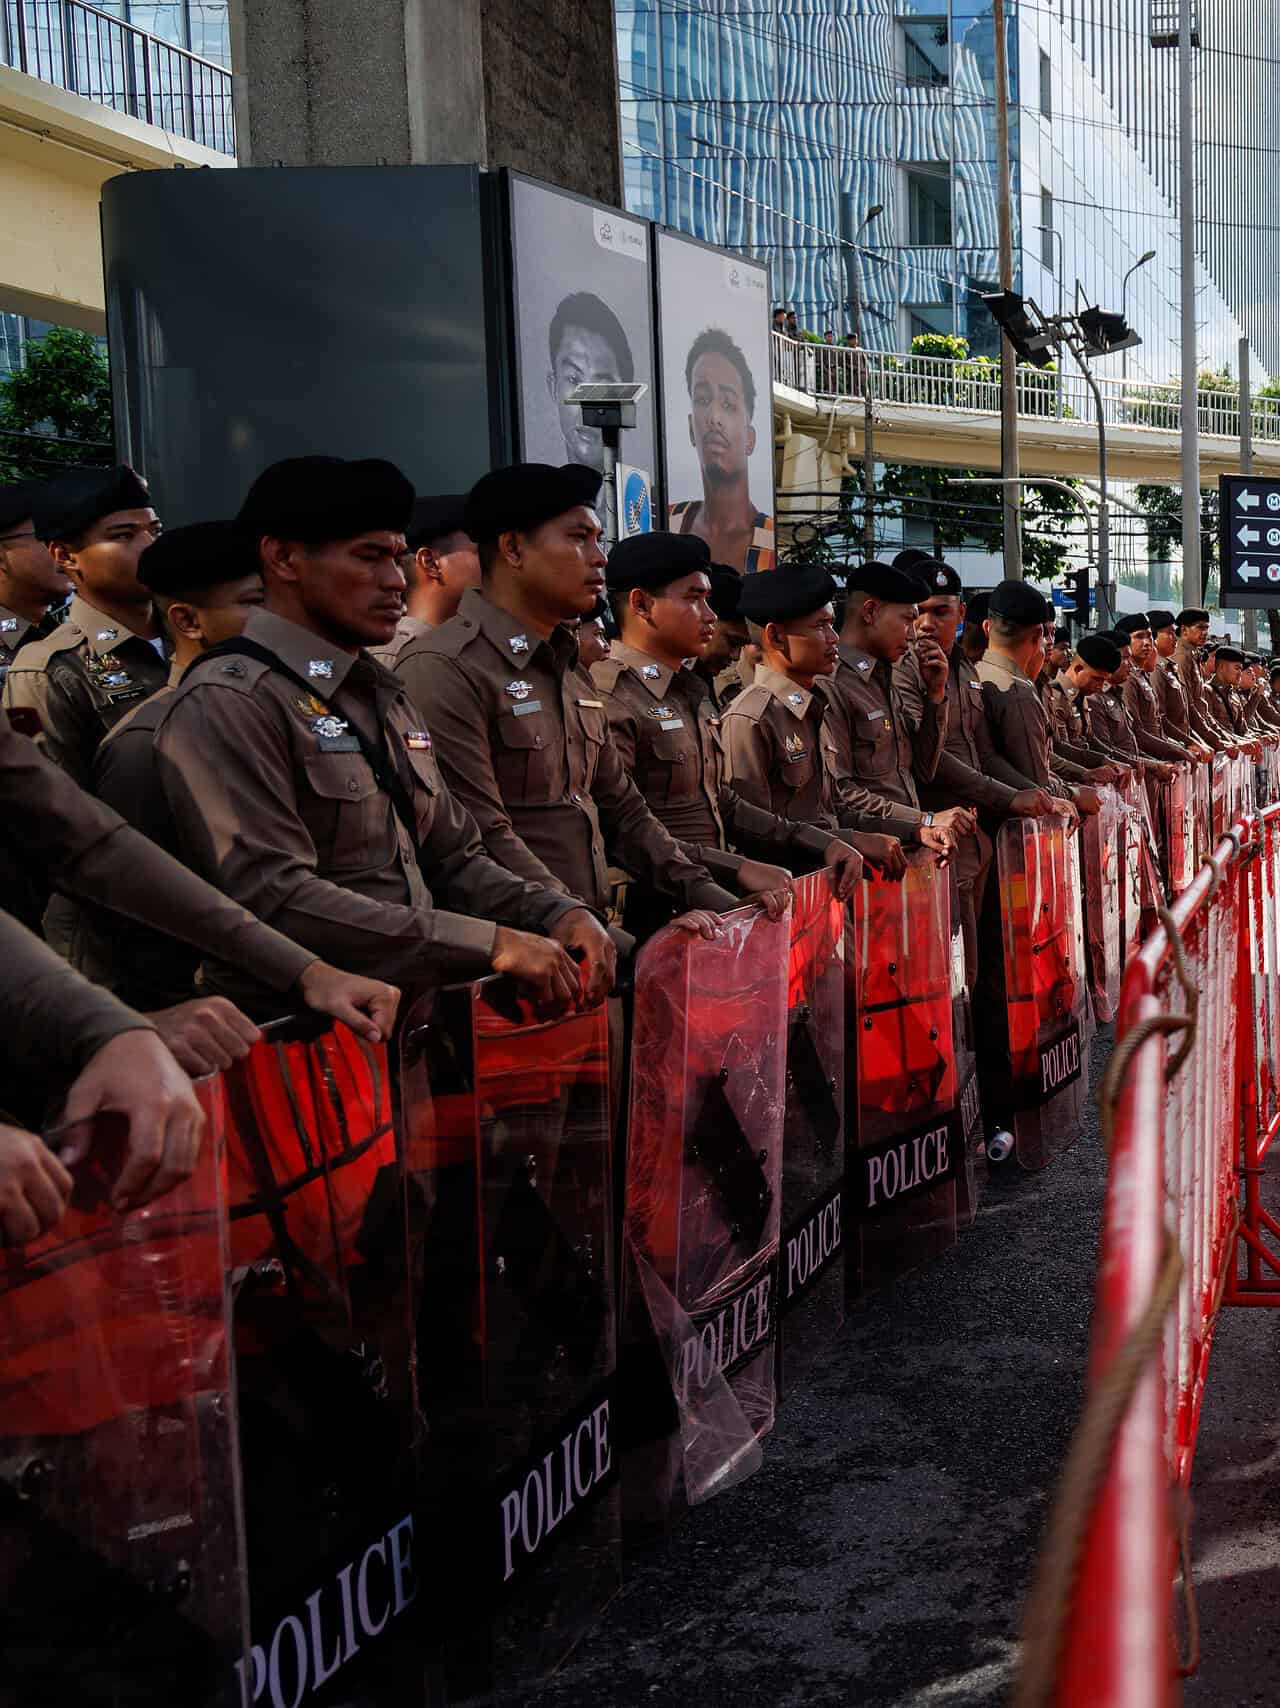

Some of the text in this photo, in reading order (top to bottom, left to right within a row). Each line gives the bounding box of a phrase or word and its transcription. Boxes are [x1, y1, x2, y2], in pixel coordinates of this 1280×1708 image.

[1042, 1033, 1079, 1093] POLICE
[867, 1126, 949, 1208] POLICE
[787, 1193, 841, 1298] POLICE
[679, 1275, 771, 1406] POLICE
[501, 1400, 611, 1581] POLICE
[234, 1513, 416, 1708] POLICE
